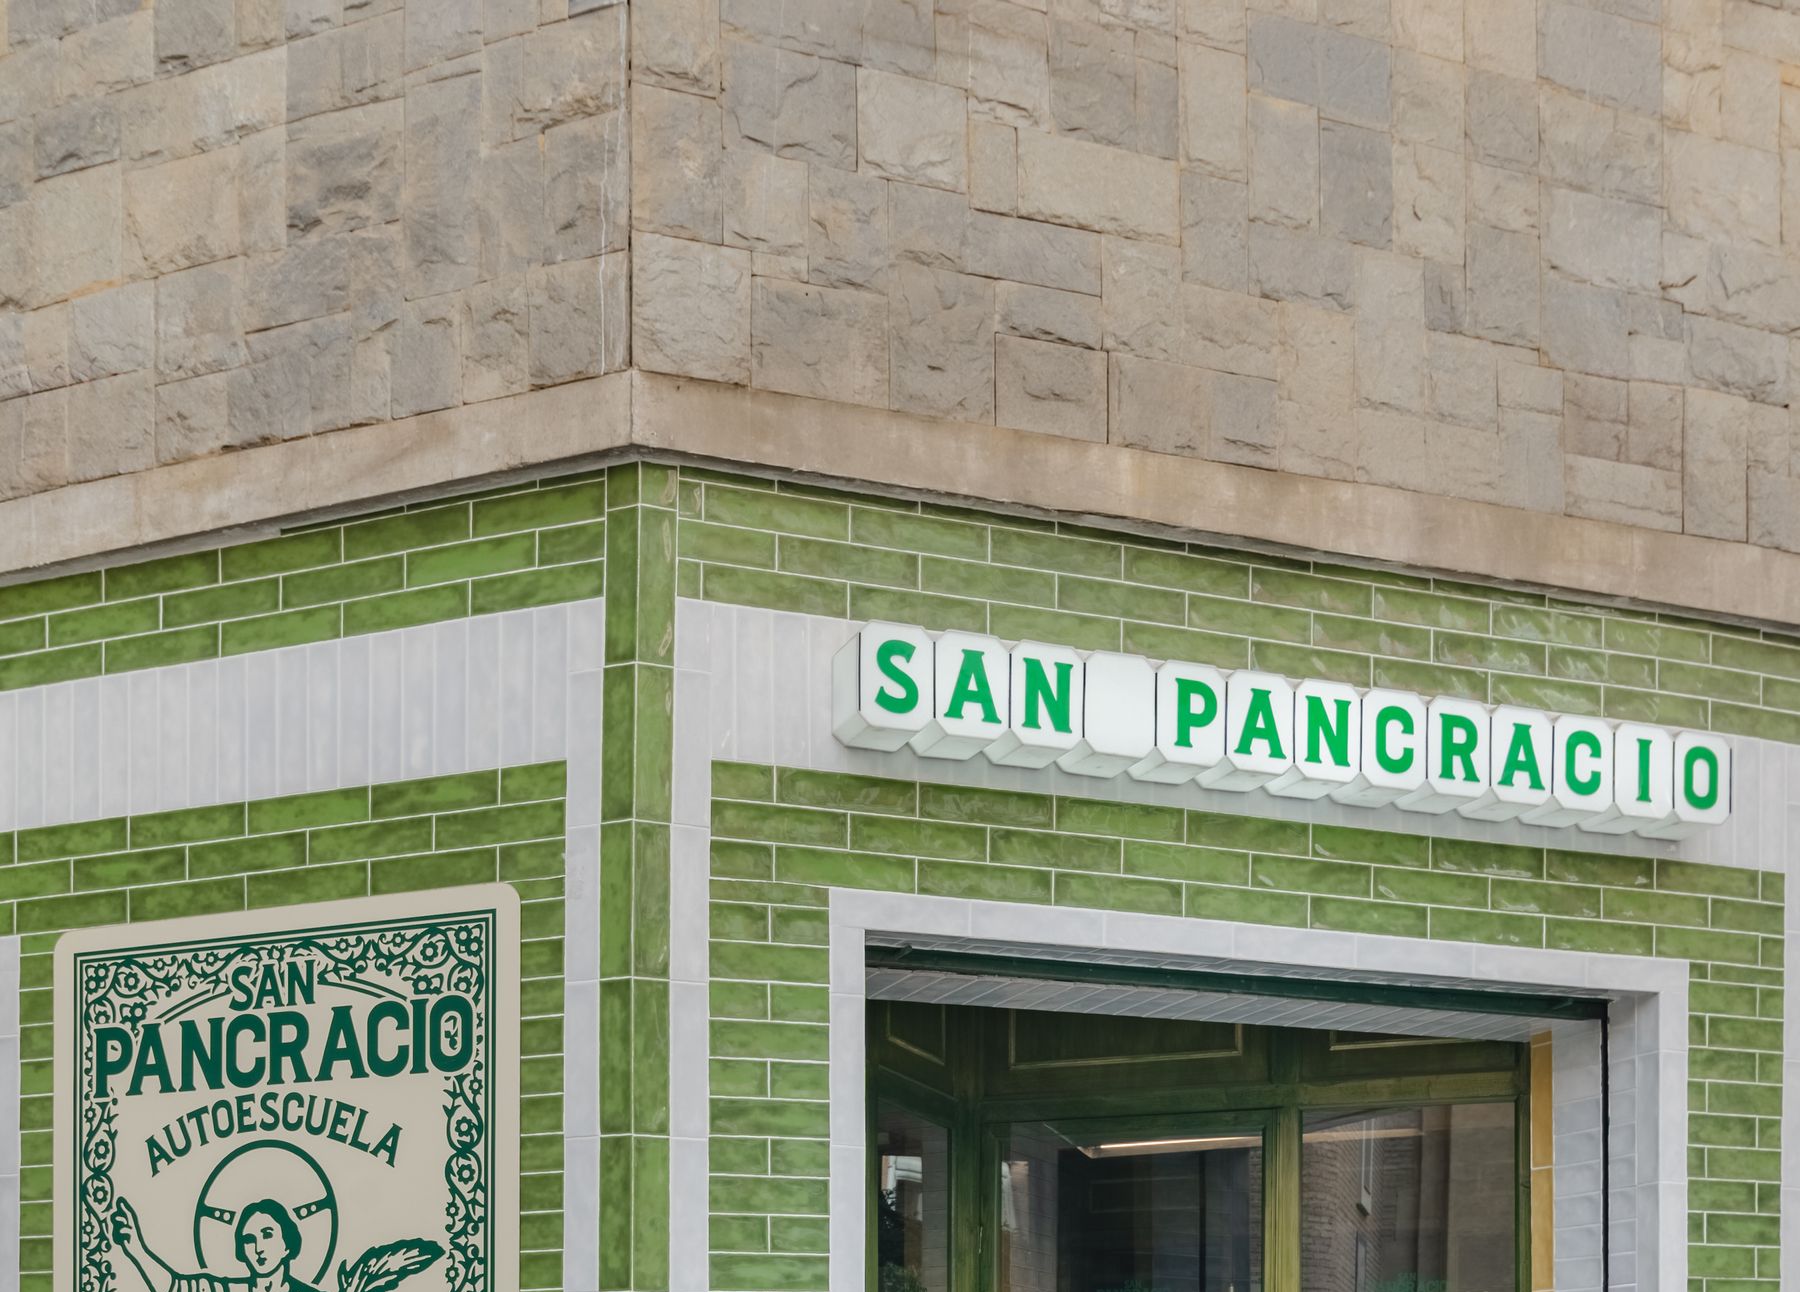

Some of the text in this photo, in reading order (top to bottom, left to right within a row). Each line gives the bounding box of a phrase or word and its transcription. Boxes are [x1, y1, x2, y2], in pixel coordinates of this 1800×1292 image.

[875, 639, 1719, 810] SAN PANCRACIO
[229, 959, 316, 1011] SAN
[93, 994, 475, 1099] PANCRACIO
[145, 1091, 403, 1178] AUTOESCUELA
[1124, 1280, 1142, 1289] SAN
